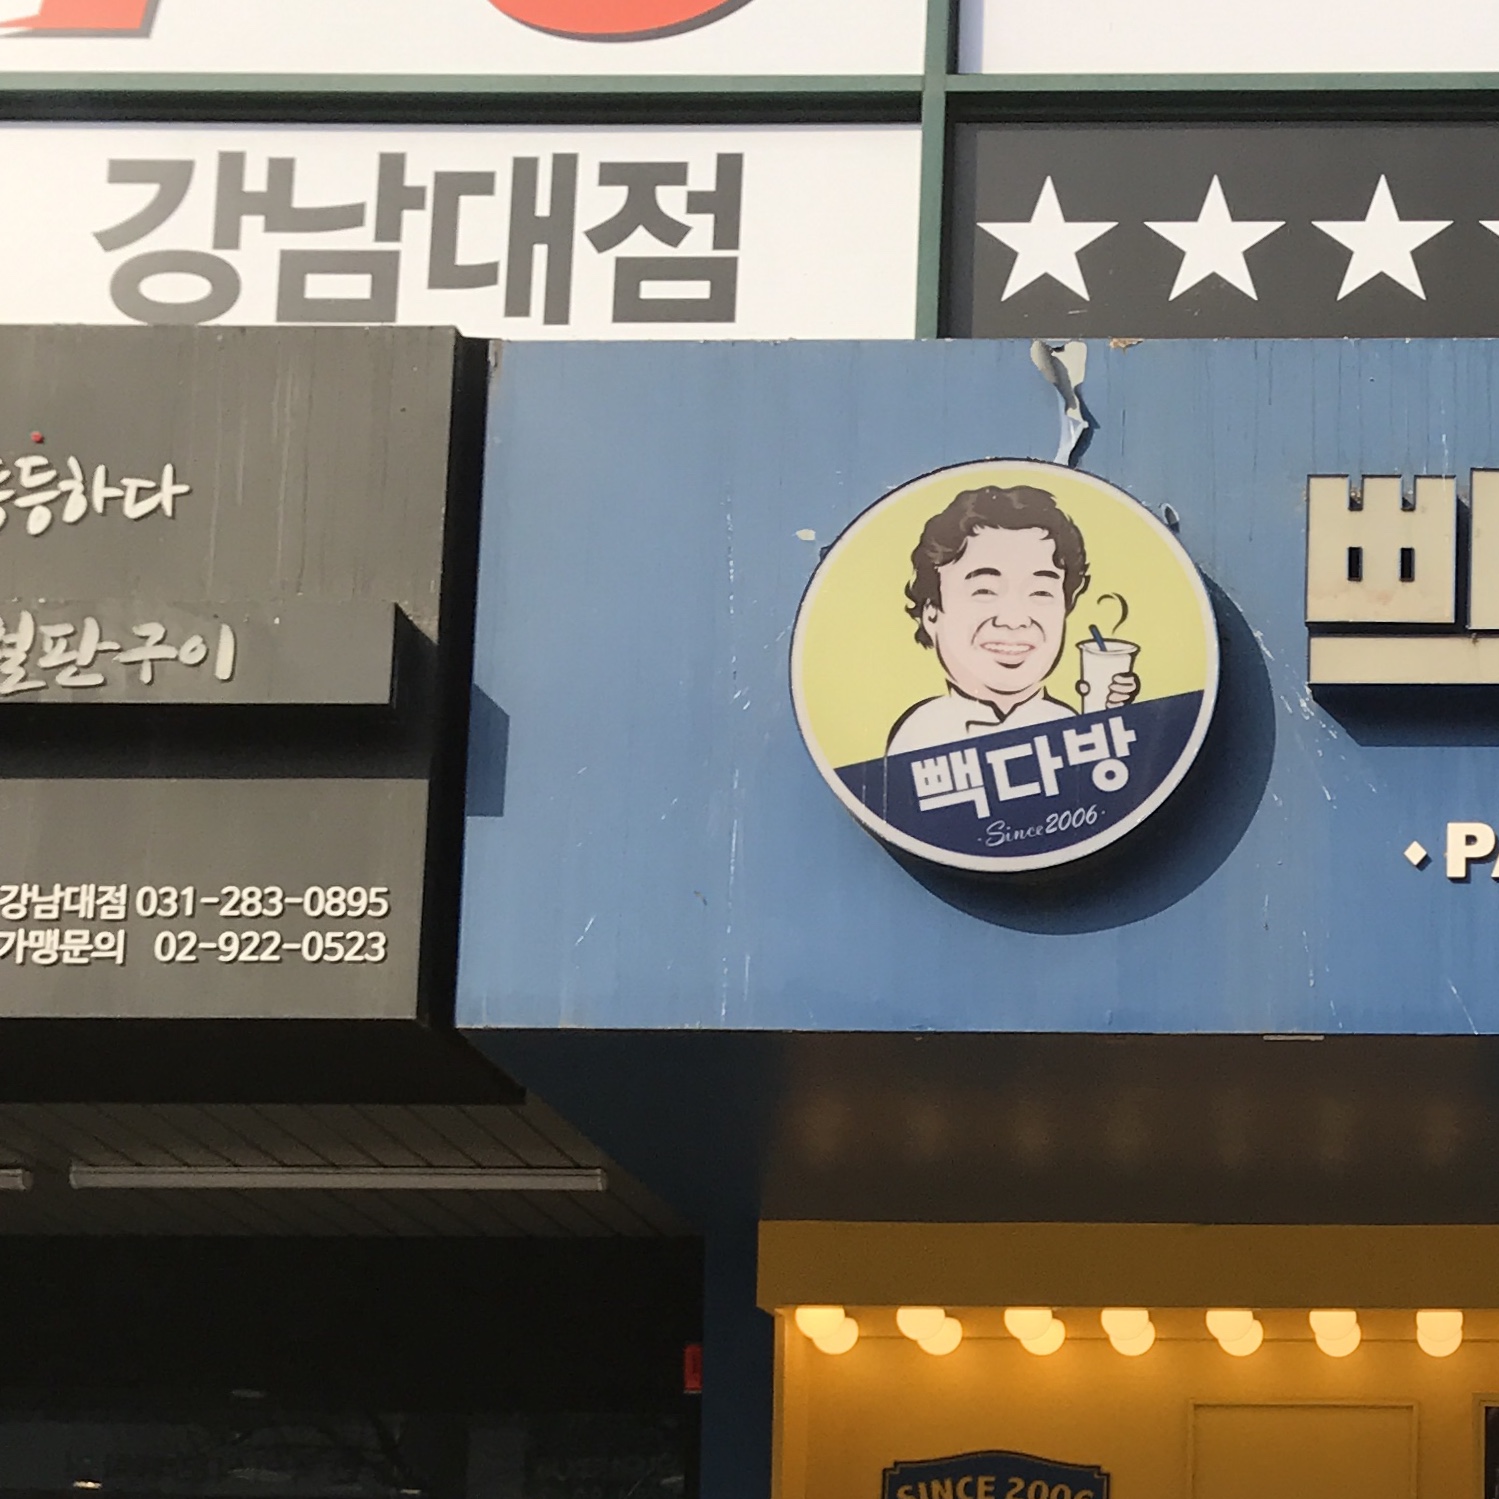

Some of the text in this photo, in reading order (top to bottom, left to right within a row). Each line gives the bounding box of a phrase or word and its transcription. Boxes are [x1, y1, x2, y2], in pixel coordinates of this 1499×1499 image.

[92, 150, 745, 326] 강남대점
[910, 715, 1137, 820] 빽다방
[0, 883, 390, 920] 강남대점 031-283-0895
[0, 927, 388, 965] 가맹문의 02-922-0523
